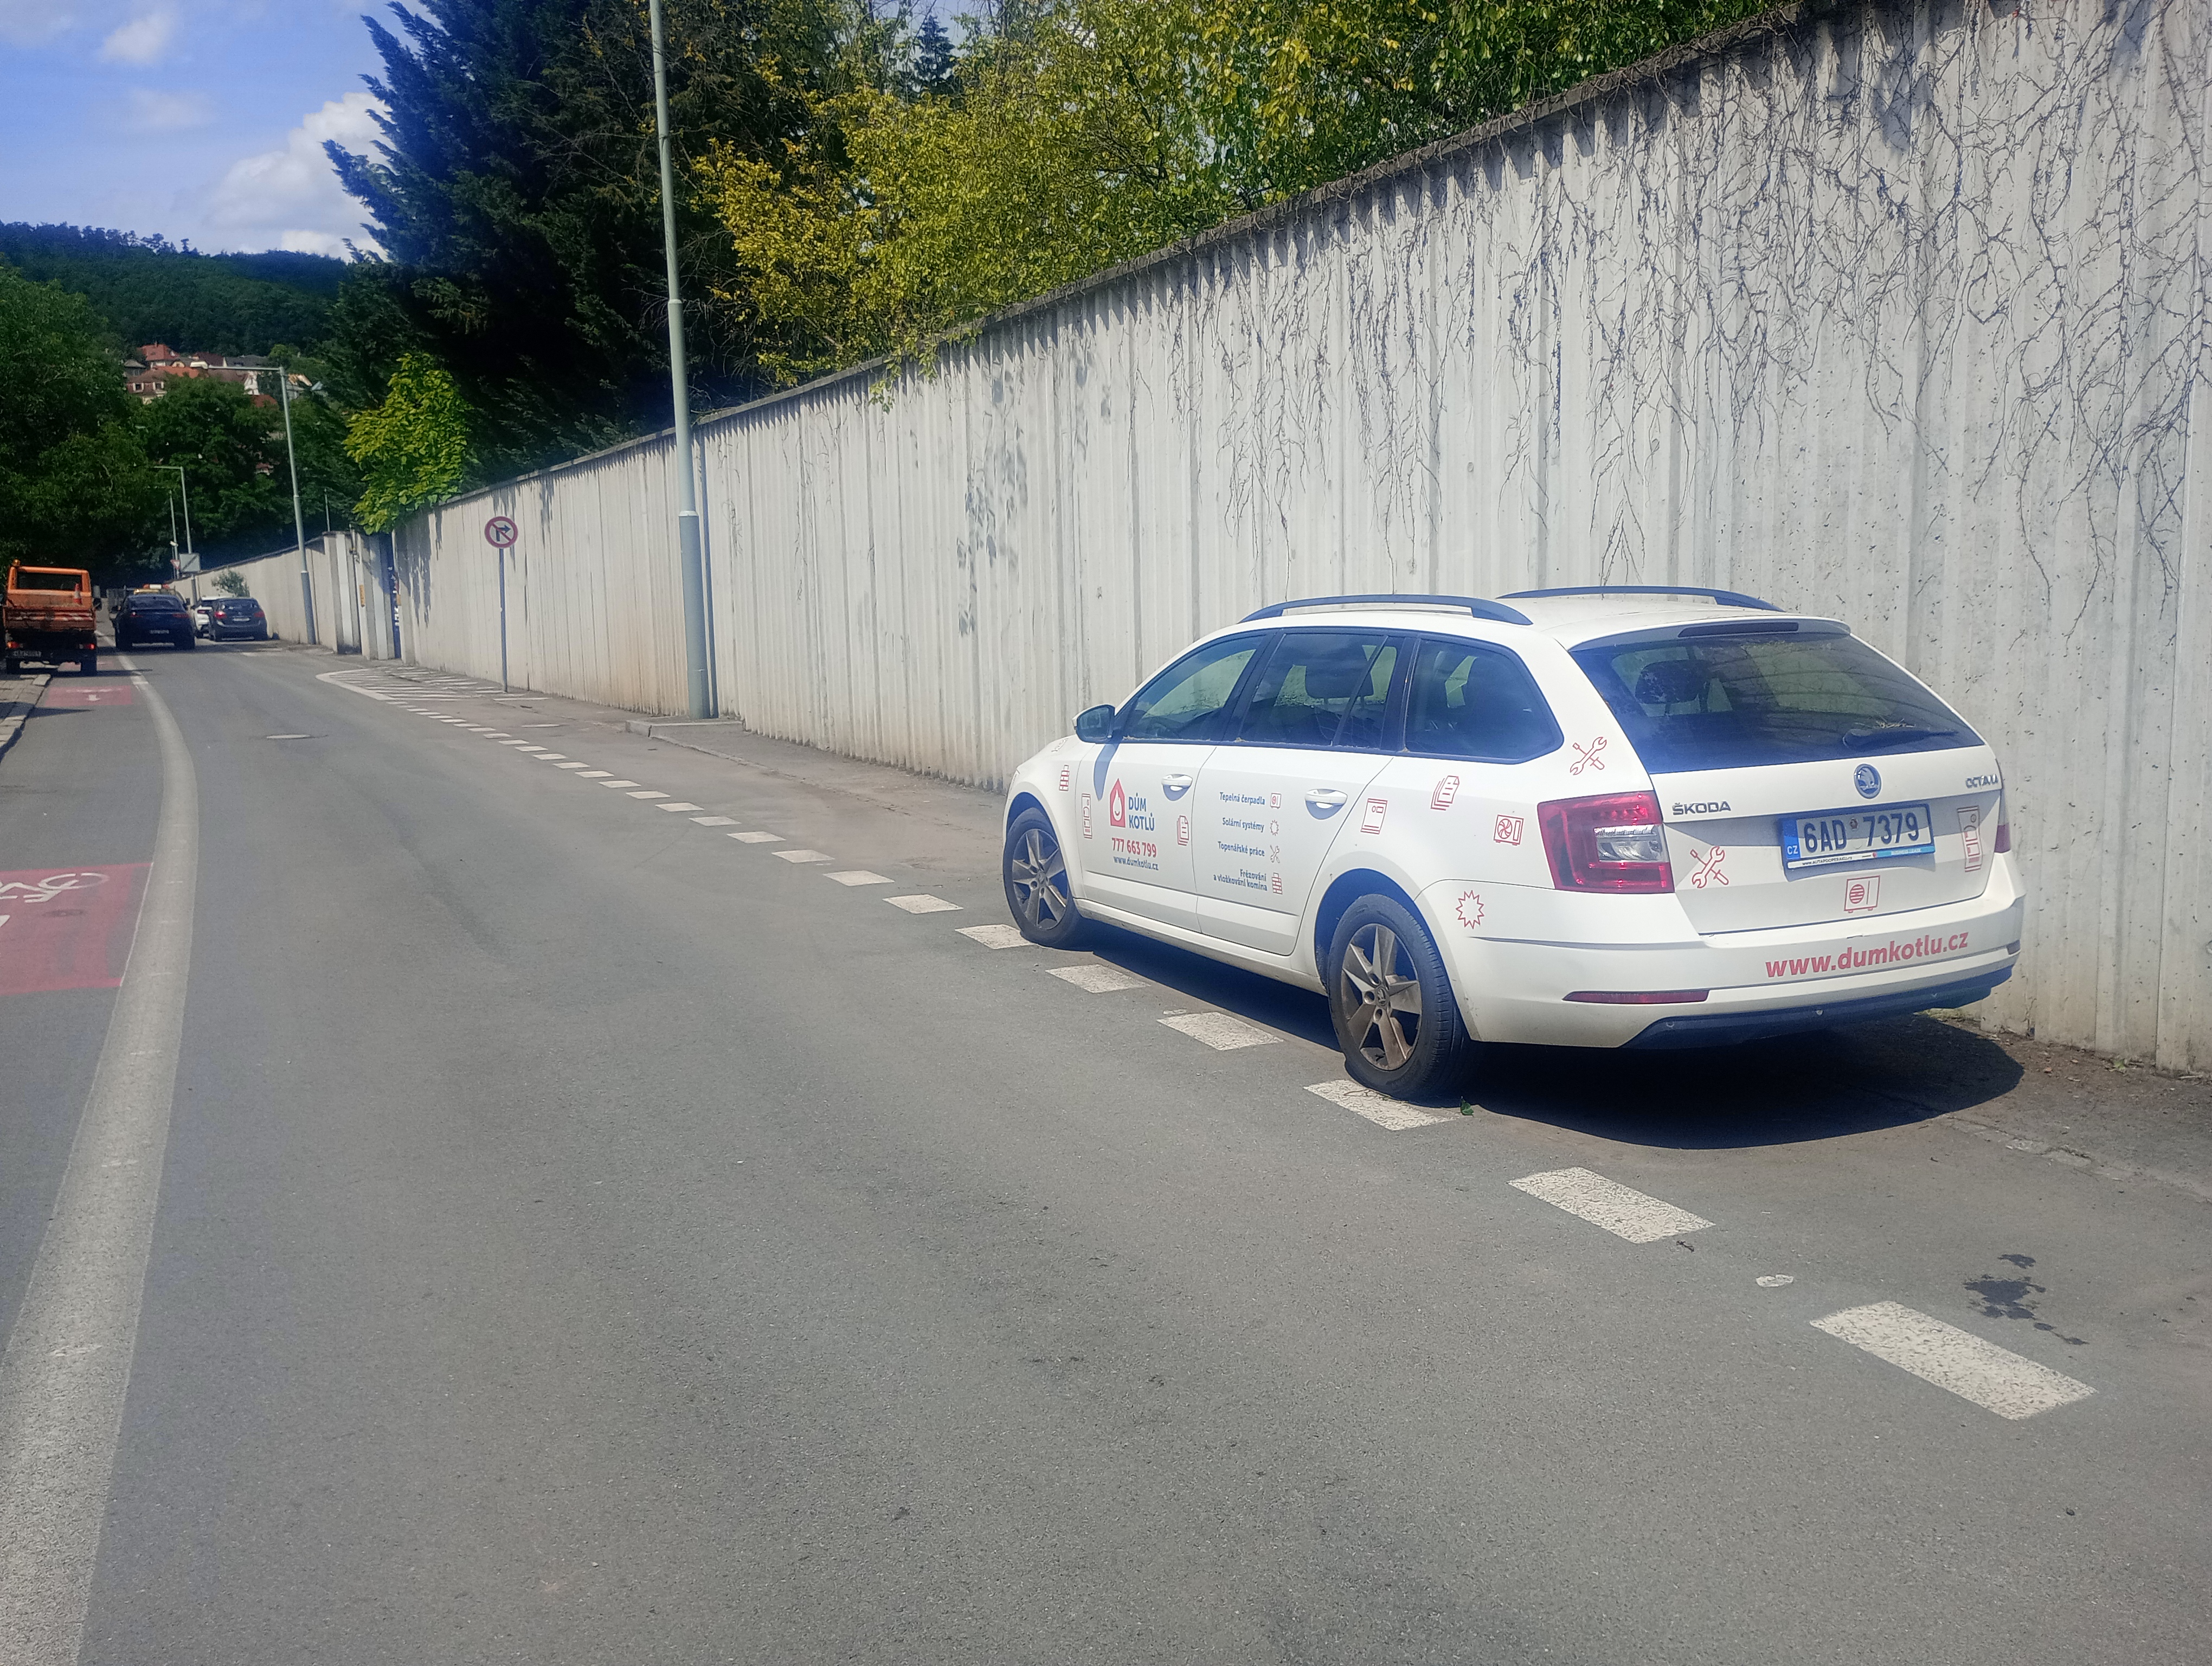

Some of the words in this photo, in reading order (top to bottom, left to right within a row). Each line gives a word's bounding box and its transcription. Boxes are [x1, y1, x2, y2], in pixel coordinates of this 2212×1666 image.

[1129, 792, 1147, 812] DŮM
[1220, 792, 1240, 803] Tepelná
[1242, 794, 1265, 805] čerpadla
[1672, 801, 1732, 815] ŠKODA
[1129, 812, 1155, 831] KOTLŮ
[1222, 817, 1242, 828] Solární
[1242, 821, 1265, 832] systémy
[1804, 819, 1847, 853] 6AD
[1863, 812, 1919, 847] 7379
[1111, 837, 1124, 853] 777
[1127, 840, 1141, 855] 663
[1142, 842, 1157, 858] 799
[1218, 841, 1248, 854] Topenářské
[1249, 847, 1265, 856] práce
[1787, 845, 1799, 855] CZ
[1113, 856, 1159, 871] www.dumkotlu.cz
[1240, 868, 1266, 882] Frézování
[1247, 878, 1268, 891] komína
[1765, 932, 1969, 978] www.dumkotlu.cz
